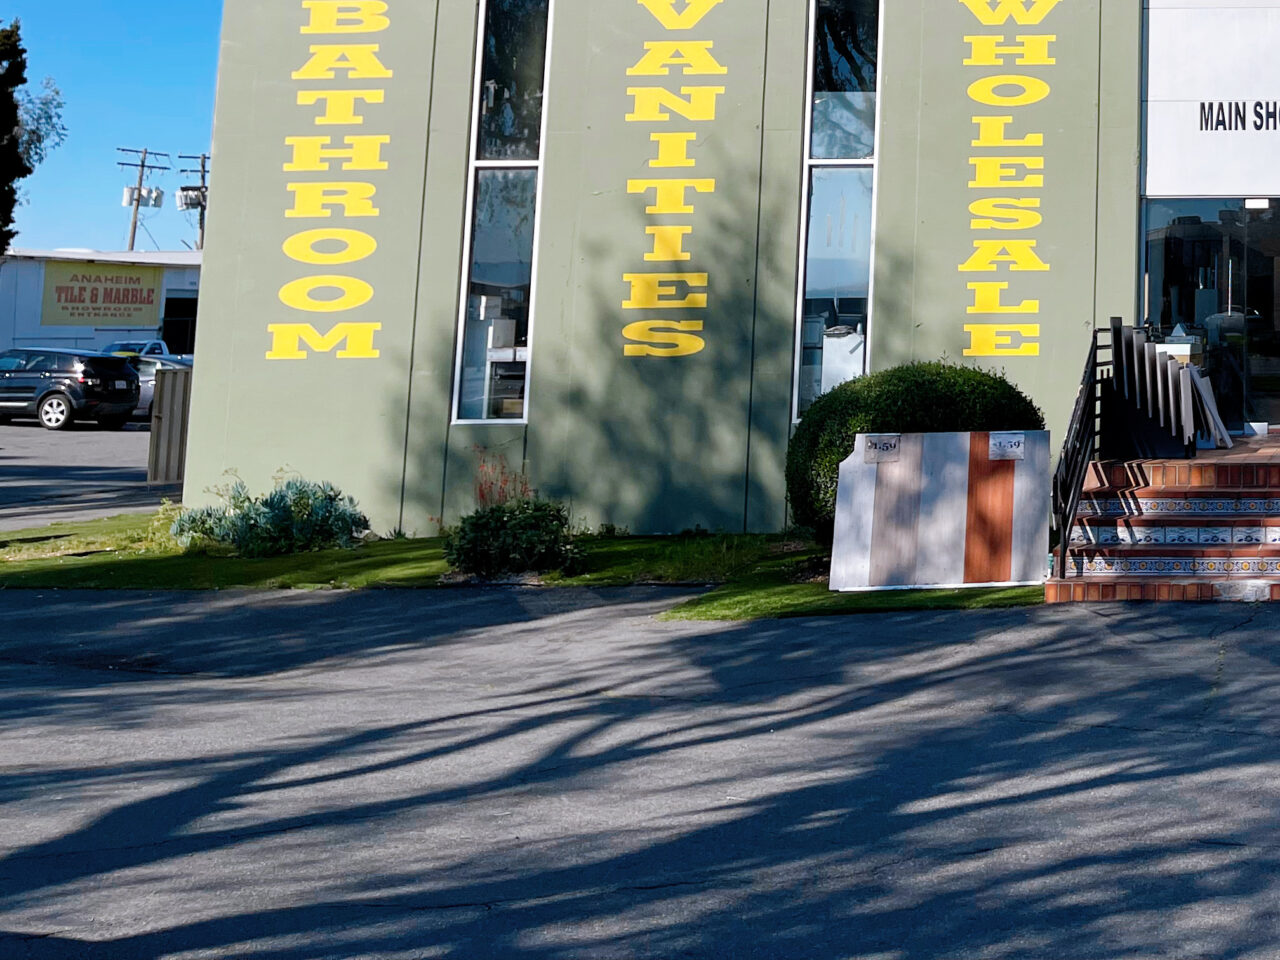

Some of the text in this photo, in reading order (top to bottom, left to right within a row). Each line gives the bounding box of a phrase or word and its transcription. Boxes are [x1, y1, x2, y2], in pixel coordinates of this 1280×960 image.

[1199, 101, 1247, 132] MAIN
[265, 0, 393, 359] BATHROOM
[69, 273, 141, 285] ANAHEIM
[55, 285, 155, 305] TILE & MARBLE
